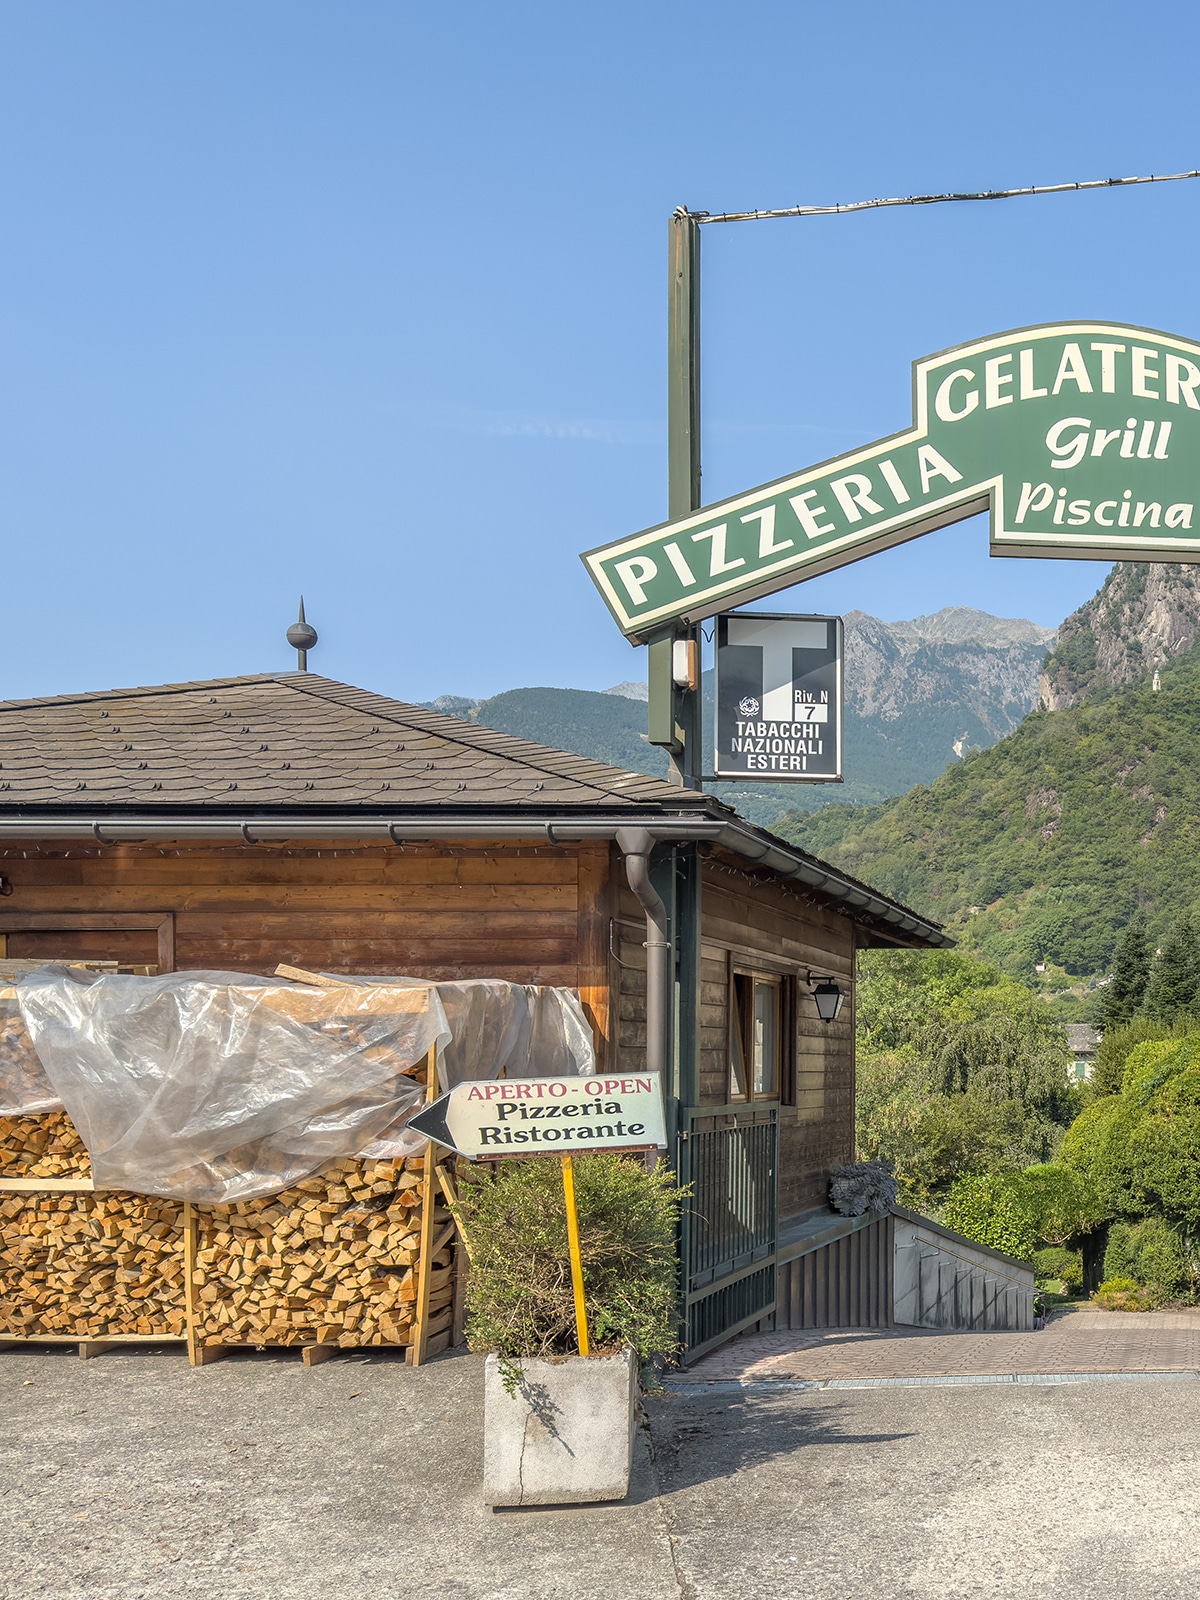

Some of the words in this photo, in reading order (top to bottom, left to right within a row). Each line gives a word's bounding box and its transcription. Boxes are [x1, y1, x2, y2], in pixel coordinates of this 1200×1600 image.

[1045, 417, 1172, 470] Grill
[1014, 481, 1194, 529] Piscina
[613, 444, 964, 606] PIZZERIA
[794, 689, 816, 703] Riv.
[804, 706, 816, 720] 7
[735, 721, 820, 739] TABACCHI
[731, 738, 823, 755] NAZIONALI
[747, 754, 807, 771] ESTERI
[467, 1082, 568, 1101] APERTO
[584, 1078, 653, 1096] OPEN
[495, 1098, 623, 1122] Pizzeria
[478, 1120, 646, 1145] Ristorante
